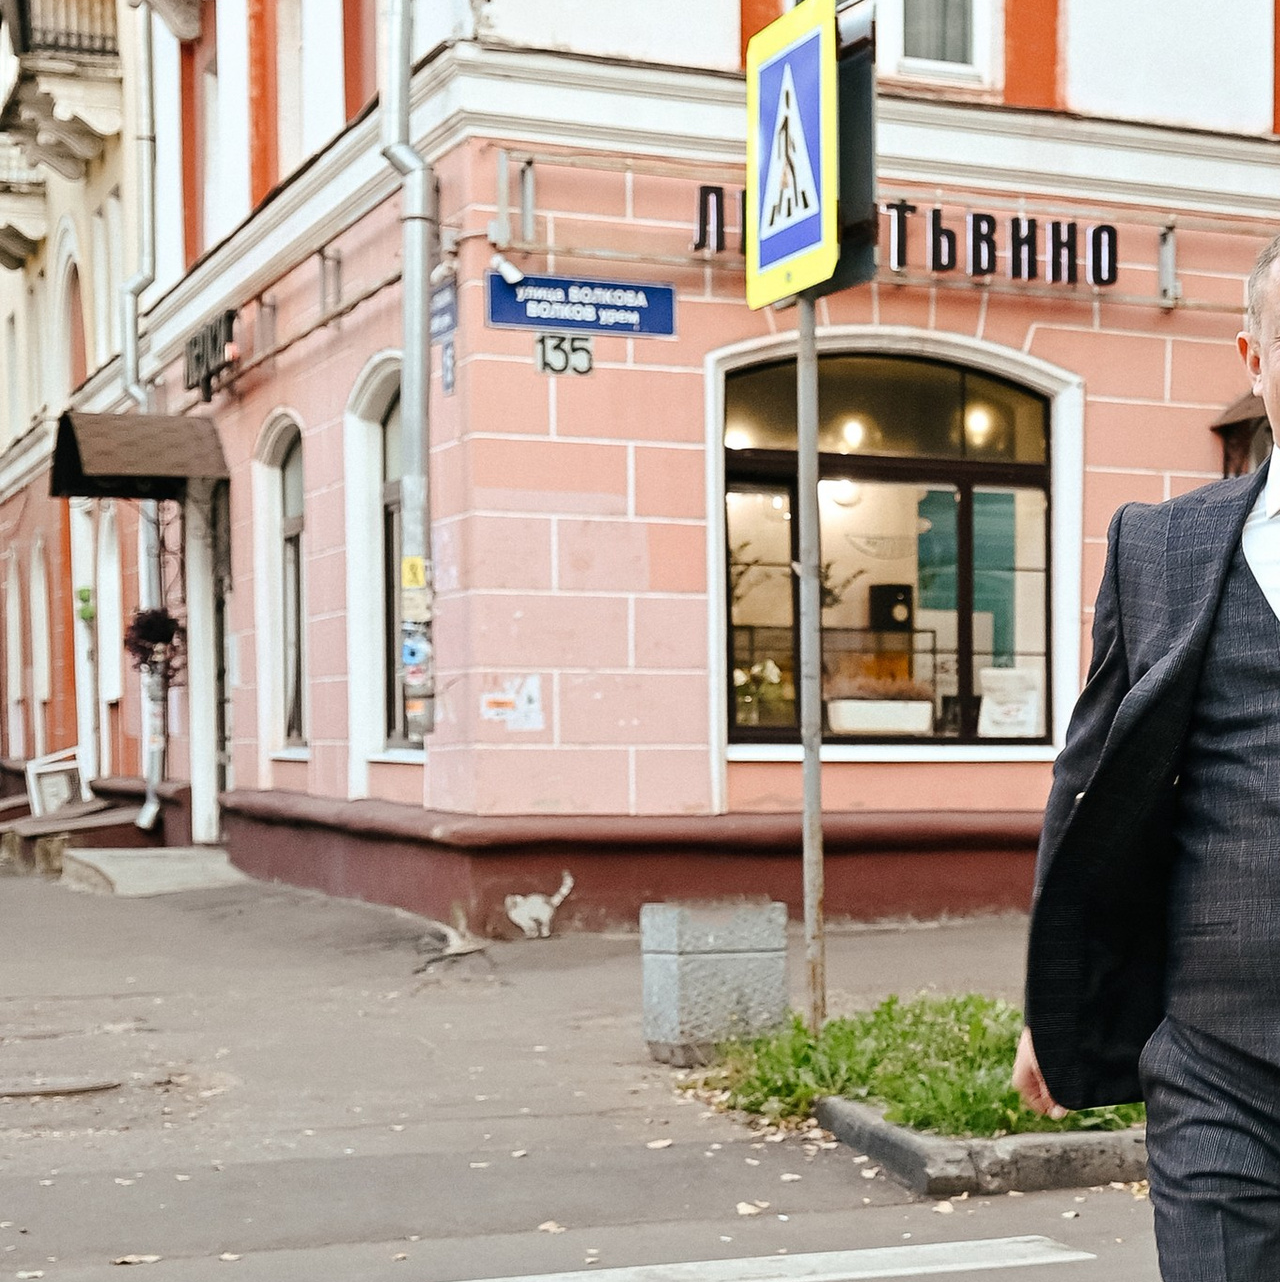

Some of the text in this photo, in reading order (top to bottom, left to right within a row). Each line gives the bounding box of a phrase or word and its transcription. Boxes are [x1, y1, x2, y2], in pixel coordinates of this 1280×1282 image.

[690, 185, 1118, 286] ЛТЬВИНО
[515, 285, 649, 308] улица ВОЛКОВА
[526, 301, 597, 322] ВОЛКОВ
[536, 335, 593, 375] 135
